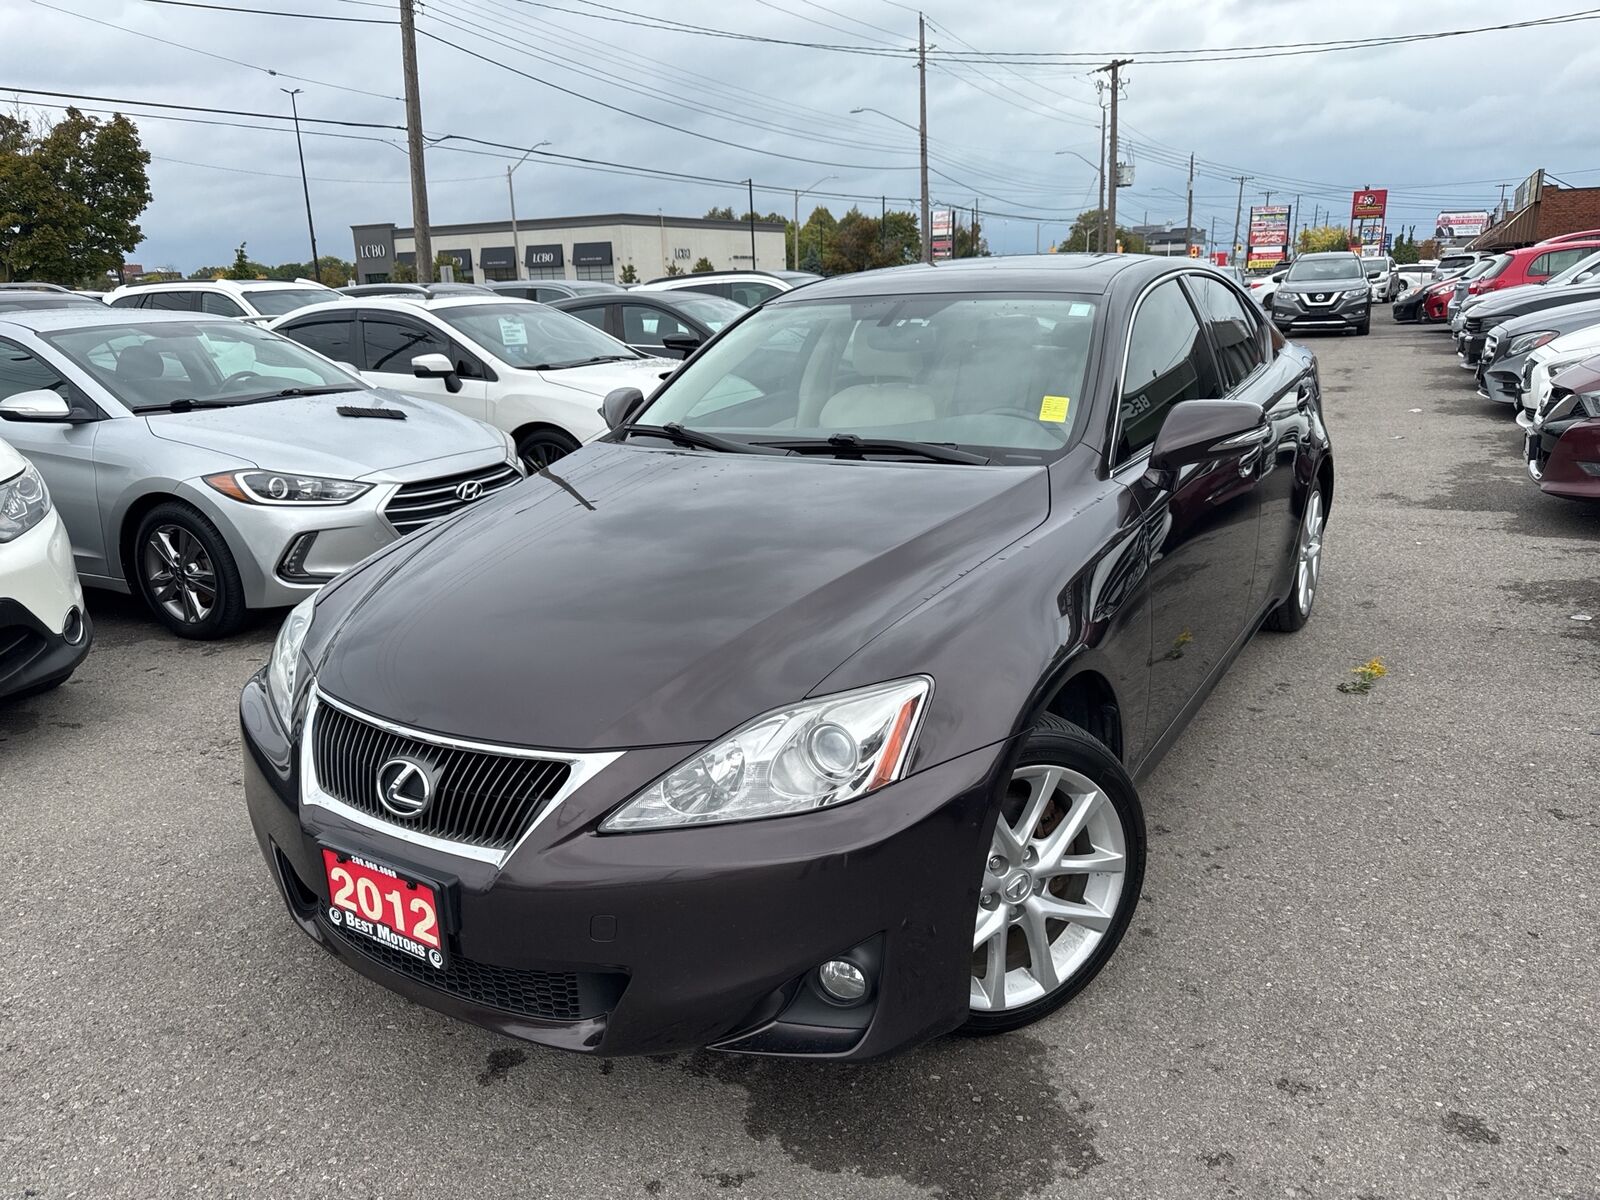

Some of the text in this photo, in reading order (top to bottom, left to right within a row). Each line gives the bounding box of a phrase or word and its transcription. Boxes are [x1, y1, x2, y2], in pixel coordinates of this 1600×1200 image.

[360, 244, 386, 258] LCBO
[532, 253, 554, 264] LCBO
[330, 867, 438, 946] 2012
